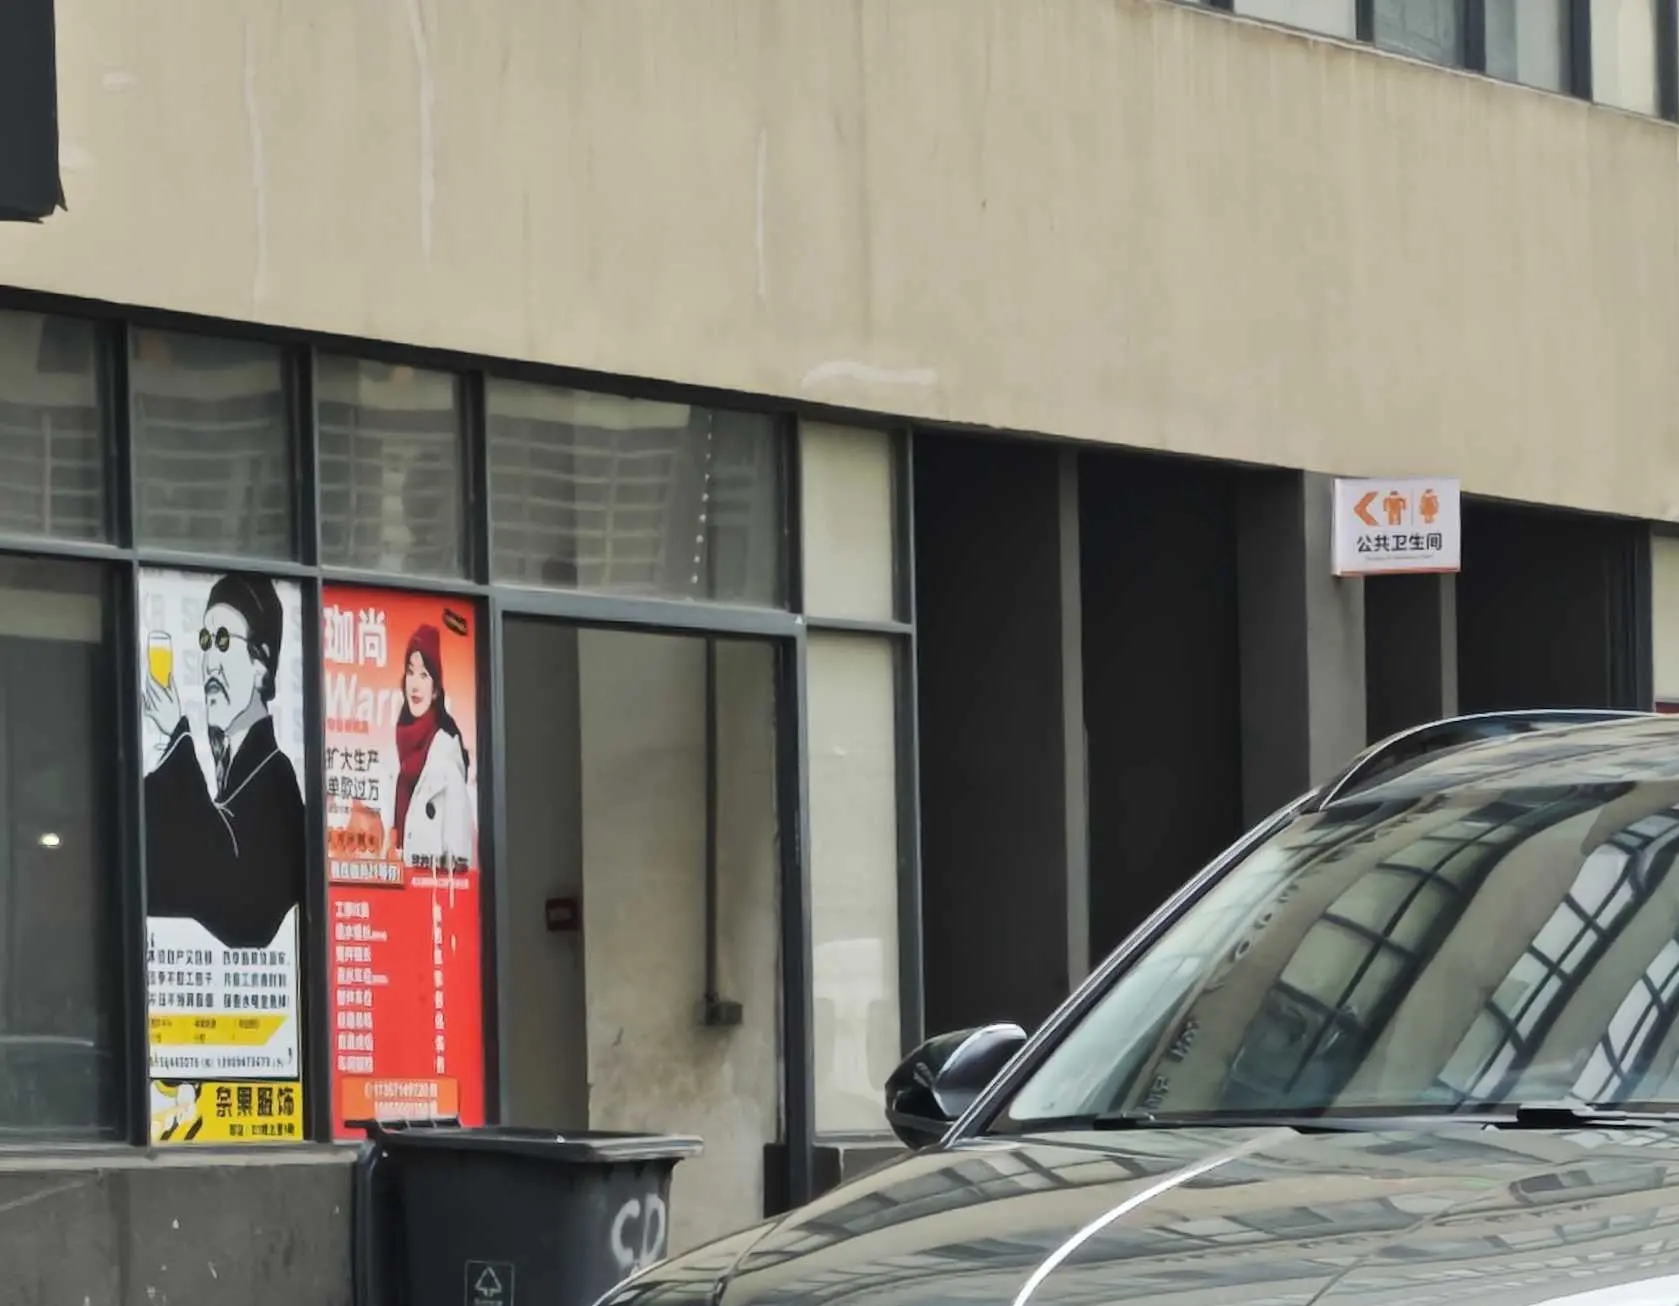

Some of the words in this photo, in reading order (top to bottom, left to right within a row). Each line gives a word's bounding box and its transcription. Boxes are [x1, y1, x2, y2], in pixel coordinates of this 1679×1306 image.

[1356, 532, 1442, 553] 公共卫生间
